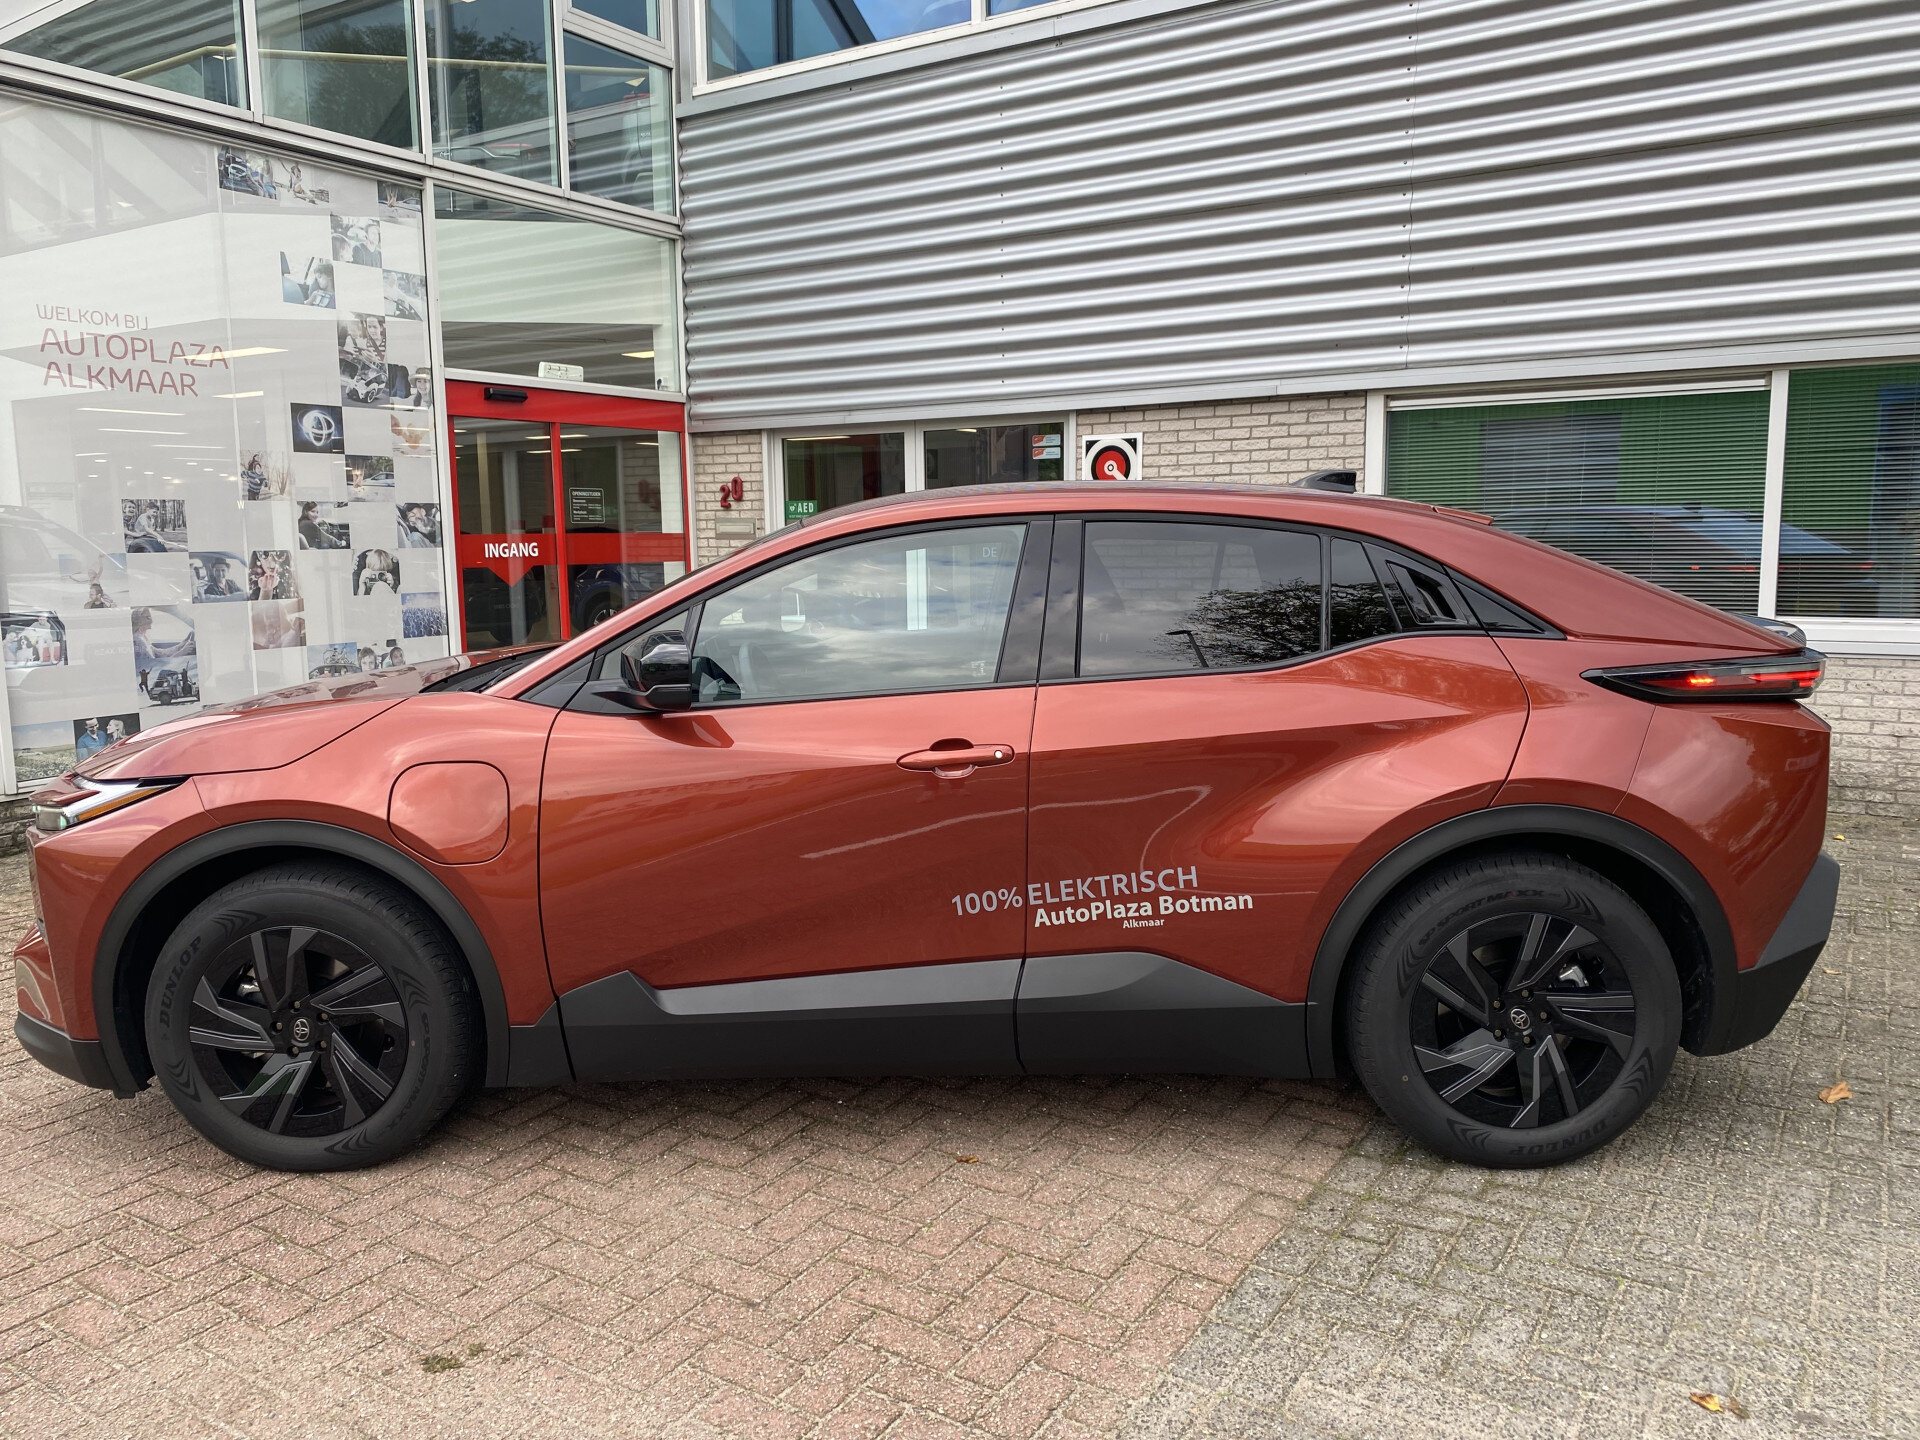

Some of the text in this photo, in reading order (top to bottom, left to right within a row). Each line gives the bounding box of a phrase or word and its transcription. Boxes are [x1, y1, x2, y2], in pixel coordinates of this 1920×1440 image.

[36, 303, 149, 331] WELKOM BIJ
[40, 327, 229, 370] AUTOPLAZA
[43, 361, 199, 397] ALKMAAR
[719, 476, 744, 509] 20
[797, 502, 814, 513] AED
[484, 542, 539, 558] INGANG
[951, 866, 1199, 916] 100% ELEKTRISCH
[1034, 894, 1254, 927] AutoPlaza Botman
[1122, 917, 1165, 929] Alkmaar
[159, 935, 202, 1028] DUNLOP
[1508, 1118, 1608, 1156] DUNLOP
